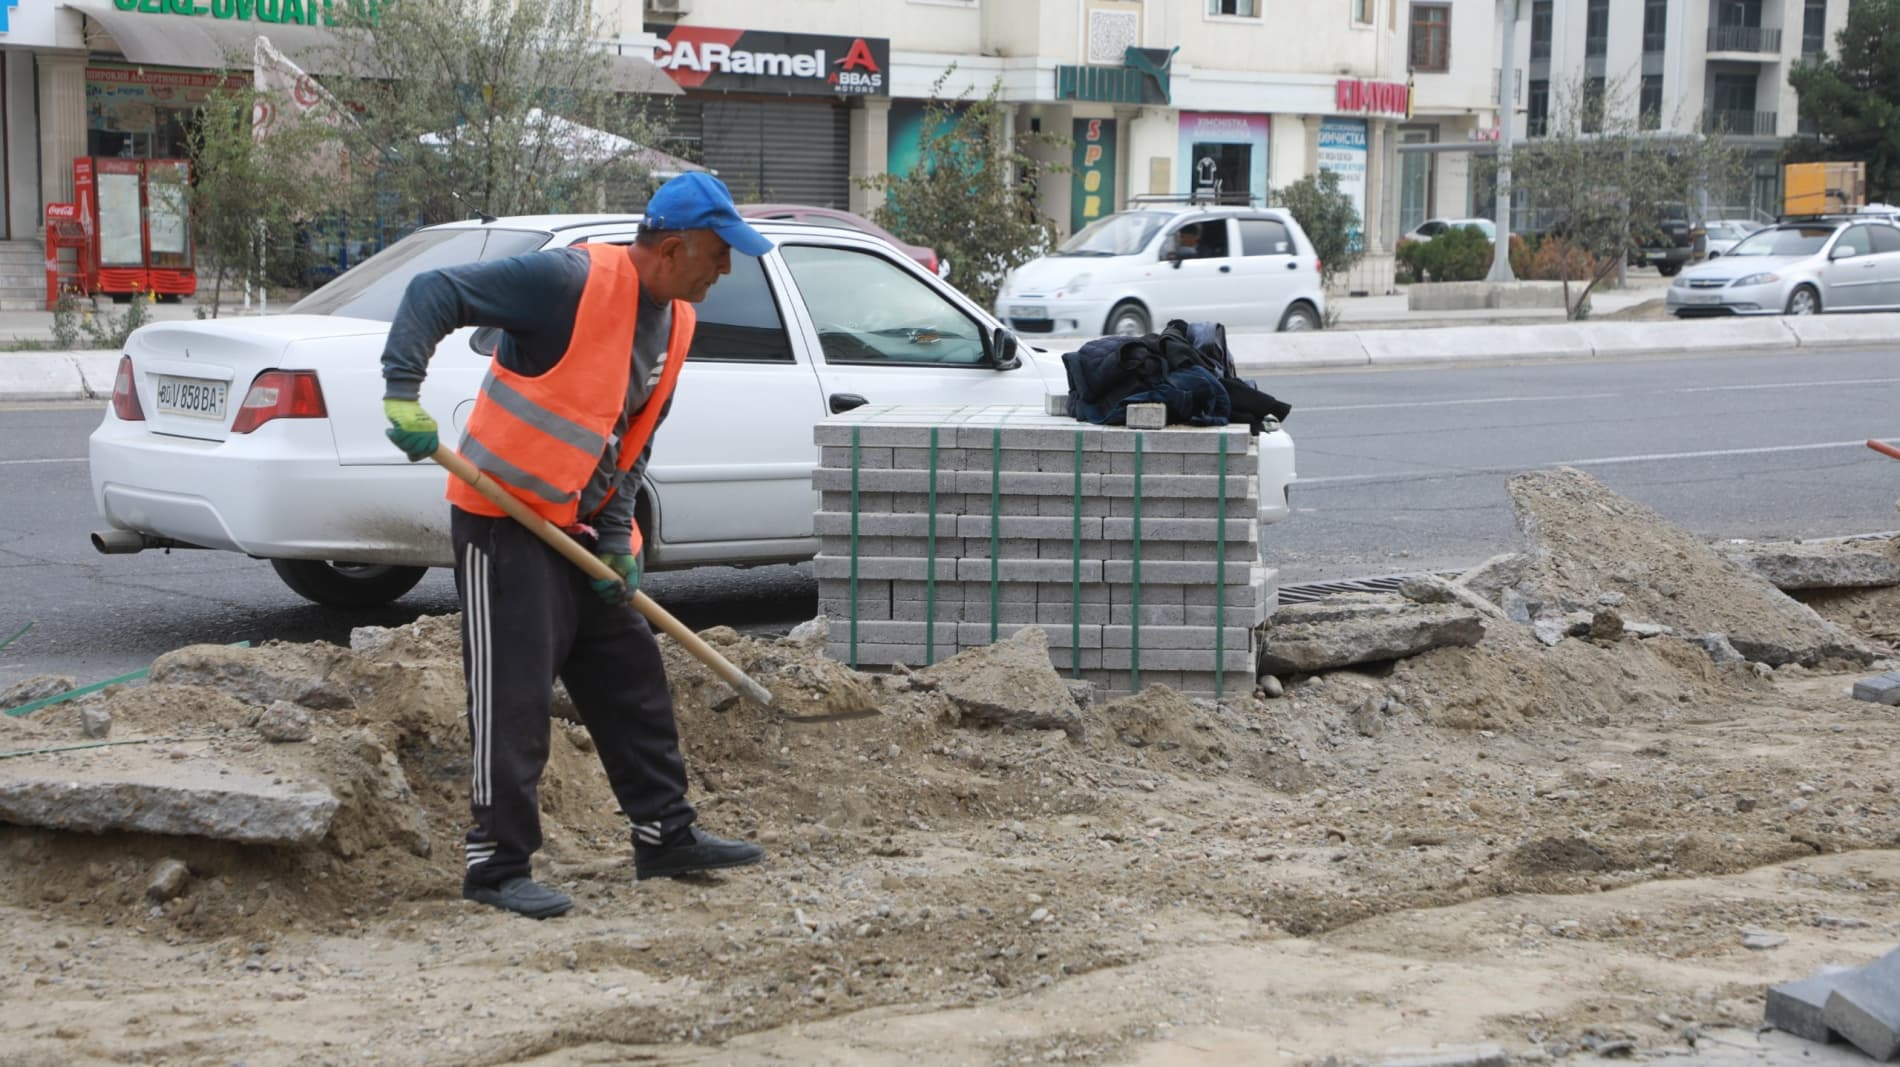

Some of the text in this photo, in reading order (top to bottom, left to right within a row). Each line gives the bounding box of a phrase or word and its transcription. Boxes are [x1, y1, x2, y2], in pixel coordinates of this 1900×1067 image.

[652, 38, 826, 78] CARamel
[827, 71, 882, 87] ABBAS
[834, 85, 875, 94] MOTORS
[1083, 119, 1103, 227] SPOR
